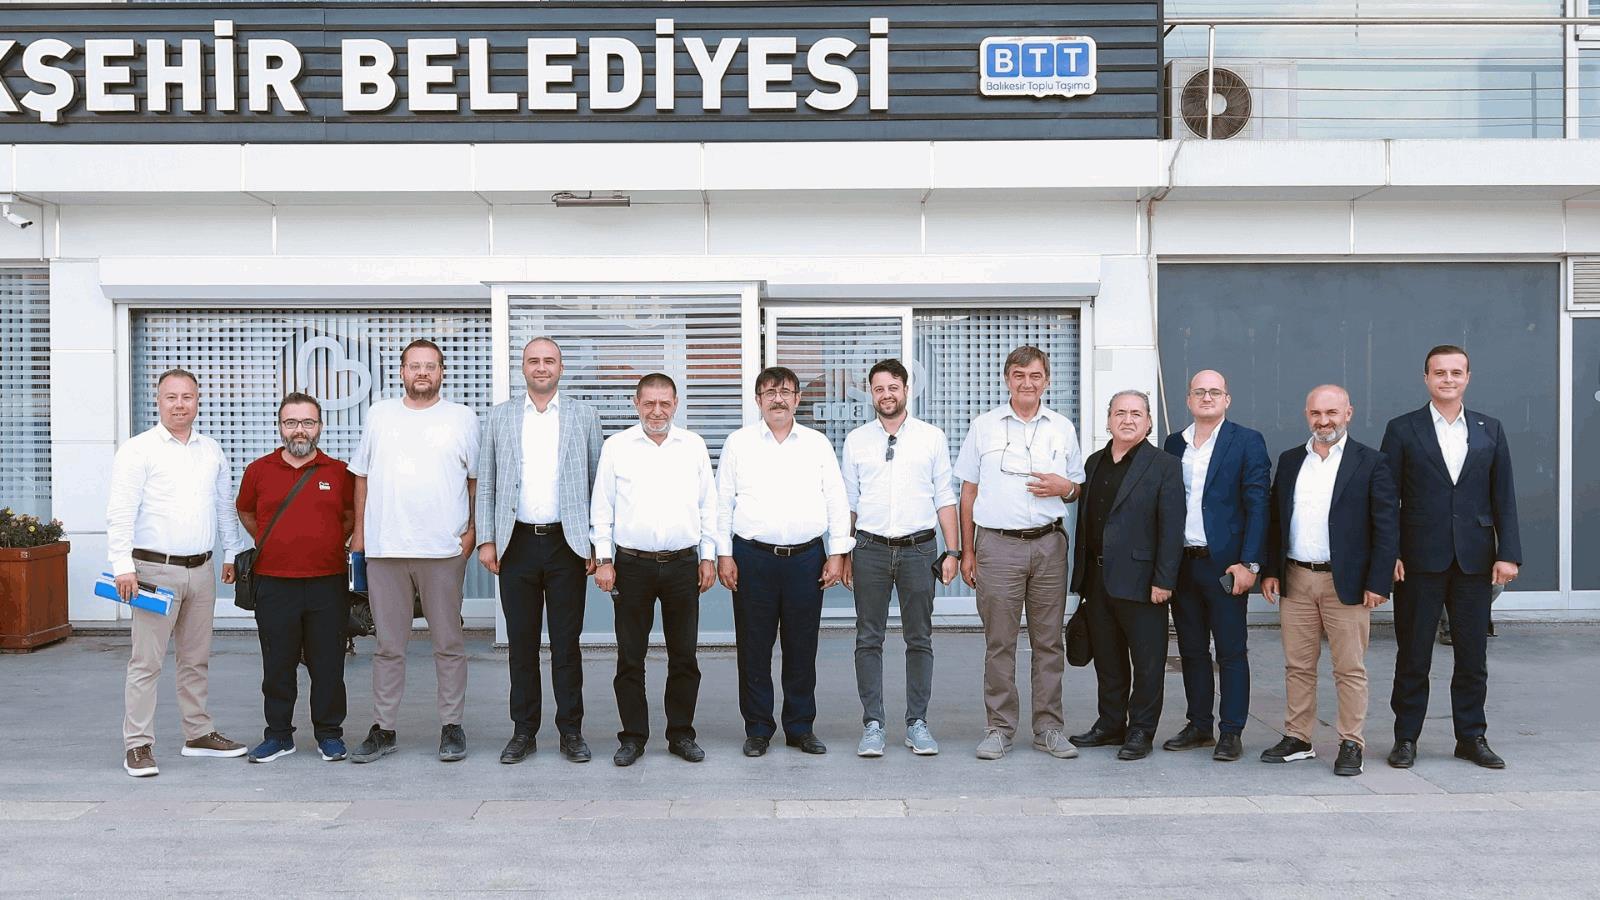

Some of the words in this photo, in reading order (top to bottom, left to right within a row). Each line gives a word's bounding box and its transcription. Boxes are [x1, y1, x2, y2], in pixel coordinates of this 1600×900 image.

[341, 17, 889, 111] BELEDİYESİ
[994, 48, 1083, 73] BTT
[1027, 81, 1054, 92] Toplu
[1056, 81, 1091, 92] Taşıma
